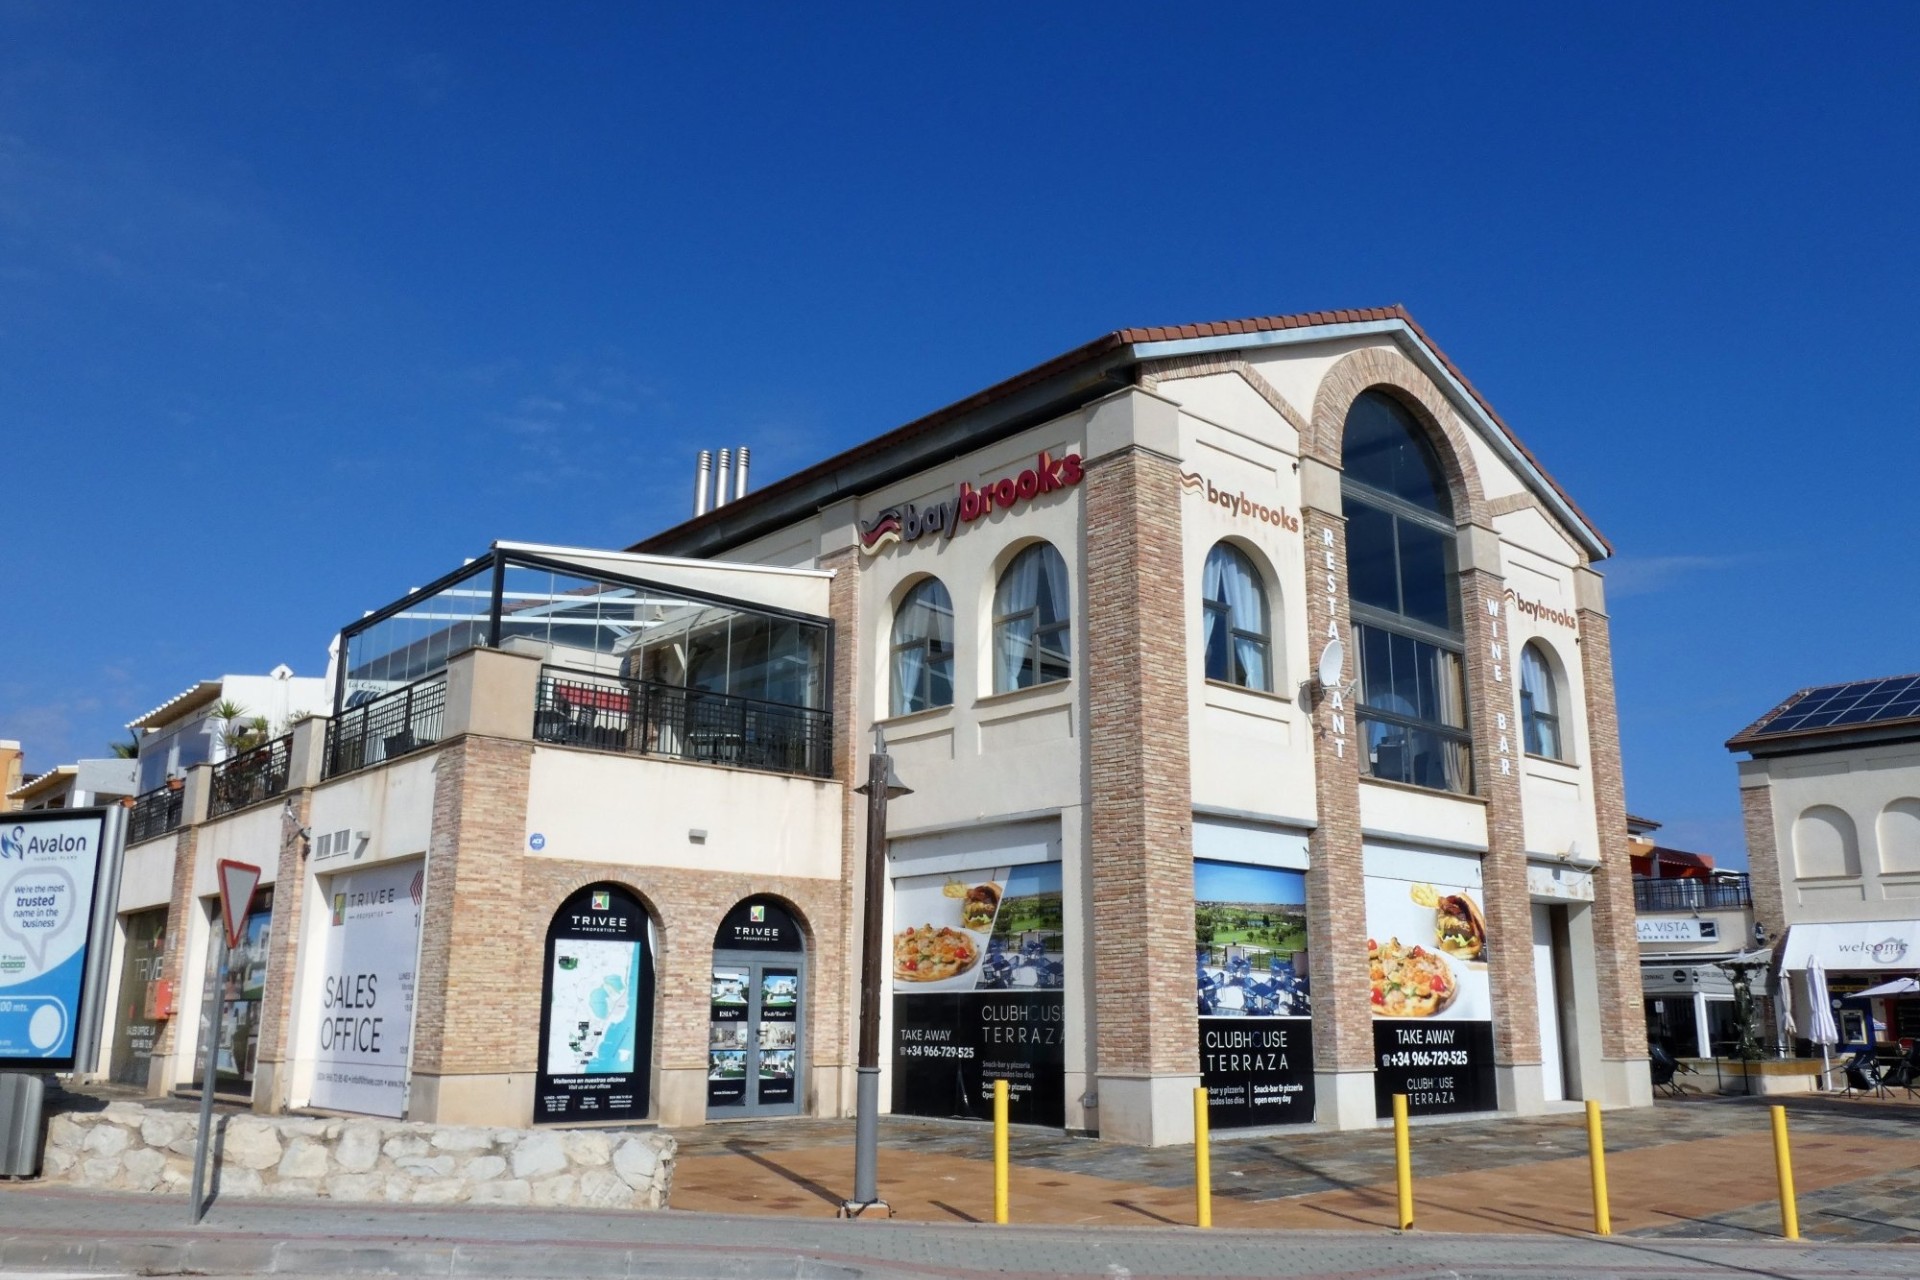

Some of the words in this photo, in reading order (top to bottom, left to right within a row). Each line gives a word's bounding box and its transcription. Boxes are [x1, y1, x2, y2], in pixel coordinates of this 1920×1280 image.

[903, 451, 1085, 541] baybrooks
[1207, 479, 1299, 533] baybrooks
[1517, 592, 1576, 629] baybrooks
[1323, 527, 1345, 758] RESTAANT
[1486, 598, 1502, 682] WINE
[1497, 713, 1511, 776] BAR
[27, 833, 87, 854] Avalon
[34, 885, 46, 893] the
[47, 884, 65, 893] most
[16, 894, 55, 907] trusted
[350, 888, 395, 908] TRIVEE
[13, 909, 35, 918] name
[36, 908, 44, 917] in
[46, 907, 59, 917] the
[22, 919, 55, 928] business
[571, 915, 627, 927] TRIVEE
[1654, 921, 1690, 932] VISTA
[734, 926, 779, 937] TRIVEE
[1838, 941, 1909, 952] welcome
[324, 973, 378, 1009] SALES
[321, 1017, 383, 1053] OFFICE
[901, 1029, 923, 1041] TAKE
[924, 1029, 952, 1041] AWAY
[1396, 1029, 1423, 1044] TAKE
[1425, 1029, 1455, 1044] AWAY
[906, 1045, 922, 1057] +34
[923, 1045, 975, 1059] 966-729-525
[1391, 1051, 1410, 1067] +34
[1411, 1050, 1468, 1066] 966-729-525
[1206, 1053, 1289, 1072] TERRAZA
[1254, 1097, 1267, 1106] open
[1267, 1096, 1282, 1105] every
[1282, 1095, 1292, 1104] day
[1407, 1091, 1455, 1105] TERRAZA
